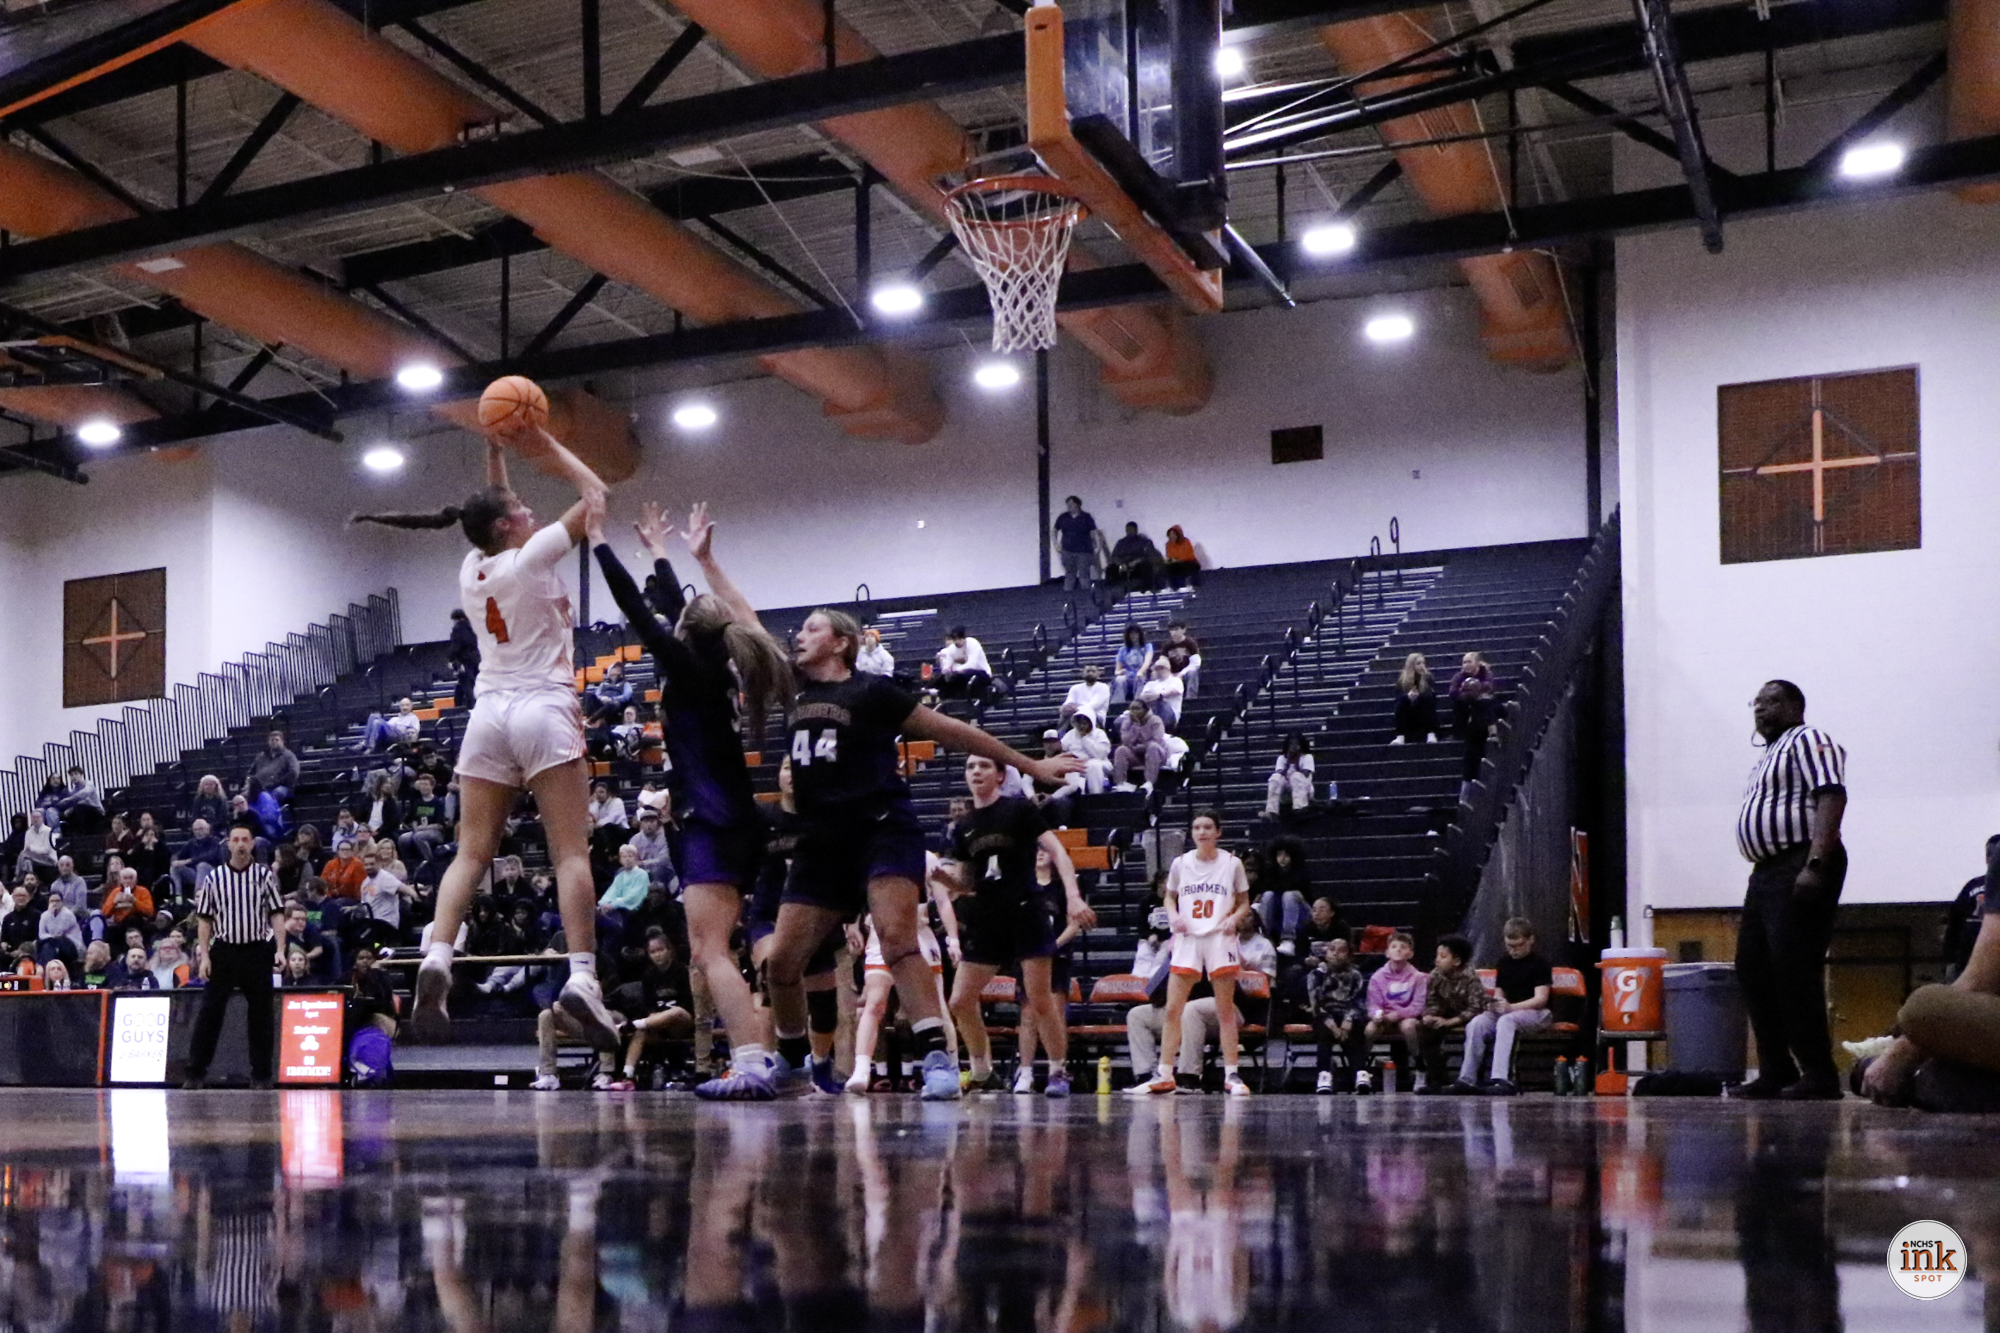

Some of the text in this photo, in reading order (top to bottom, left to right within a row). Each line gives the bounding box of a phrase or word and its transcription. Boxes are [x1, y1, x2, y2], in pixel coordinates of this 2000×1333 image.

[485, 596, 510, 644] 4
[792, 728, 838, 766] 44
[1181, 883, 1228, 896] IRONMEN
[1192, 900, 1215, 918] 20
[1227, 951, 1237, 963] N
[1616, 970, 1637, 991] G
[122, 1013, 166, 1027] GOOD
[121, 1030, 165, 1043] GUYS
